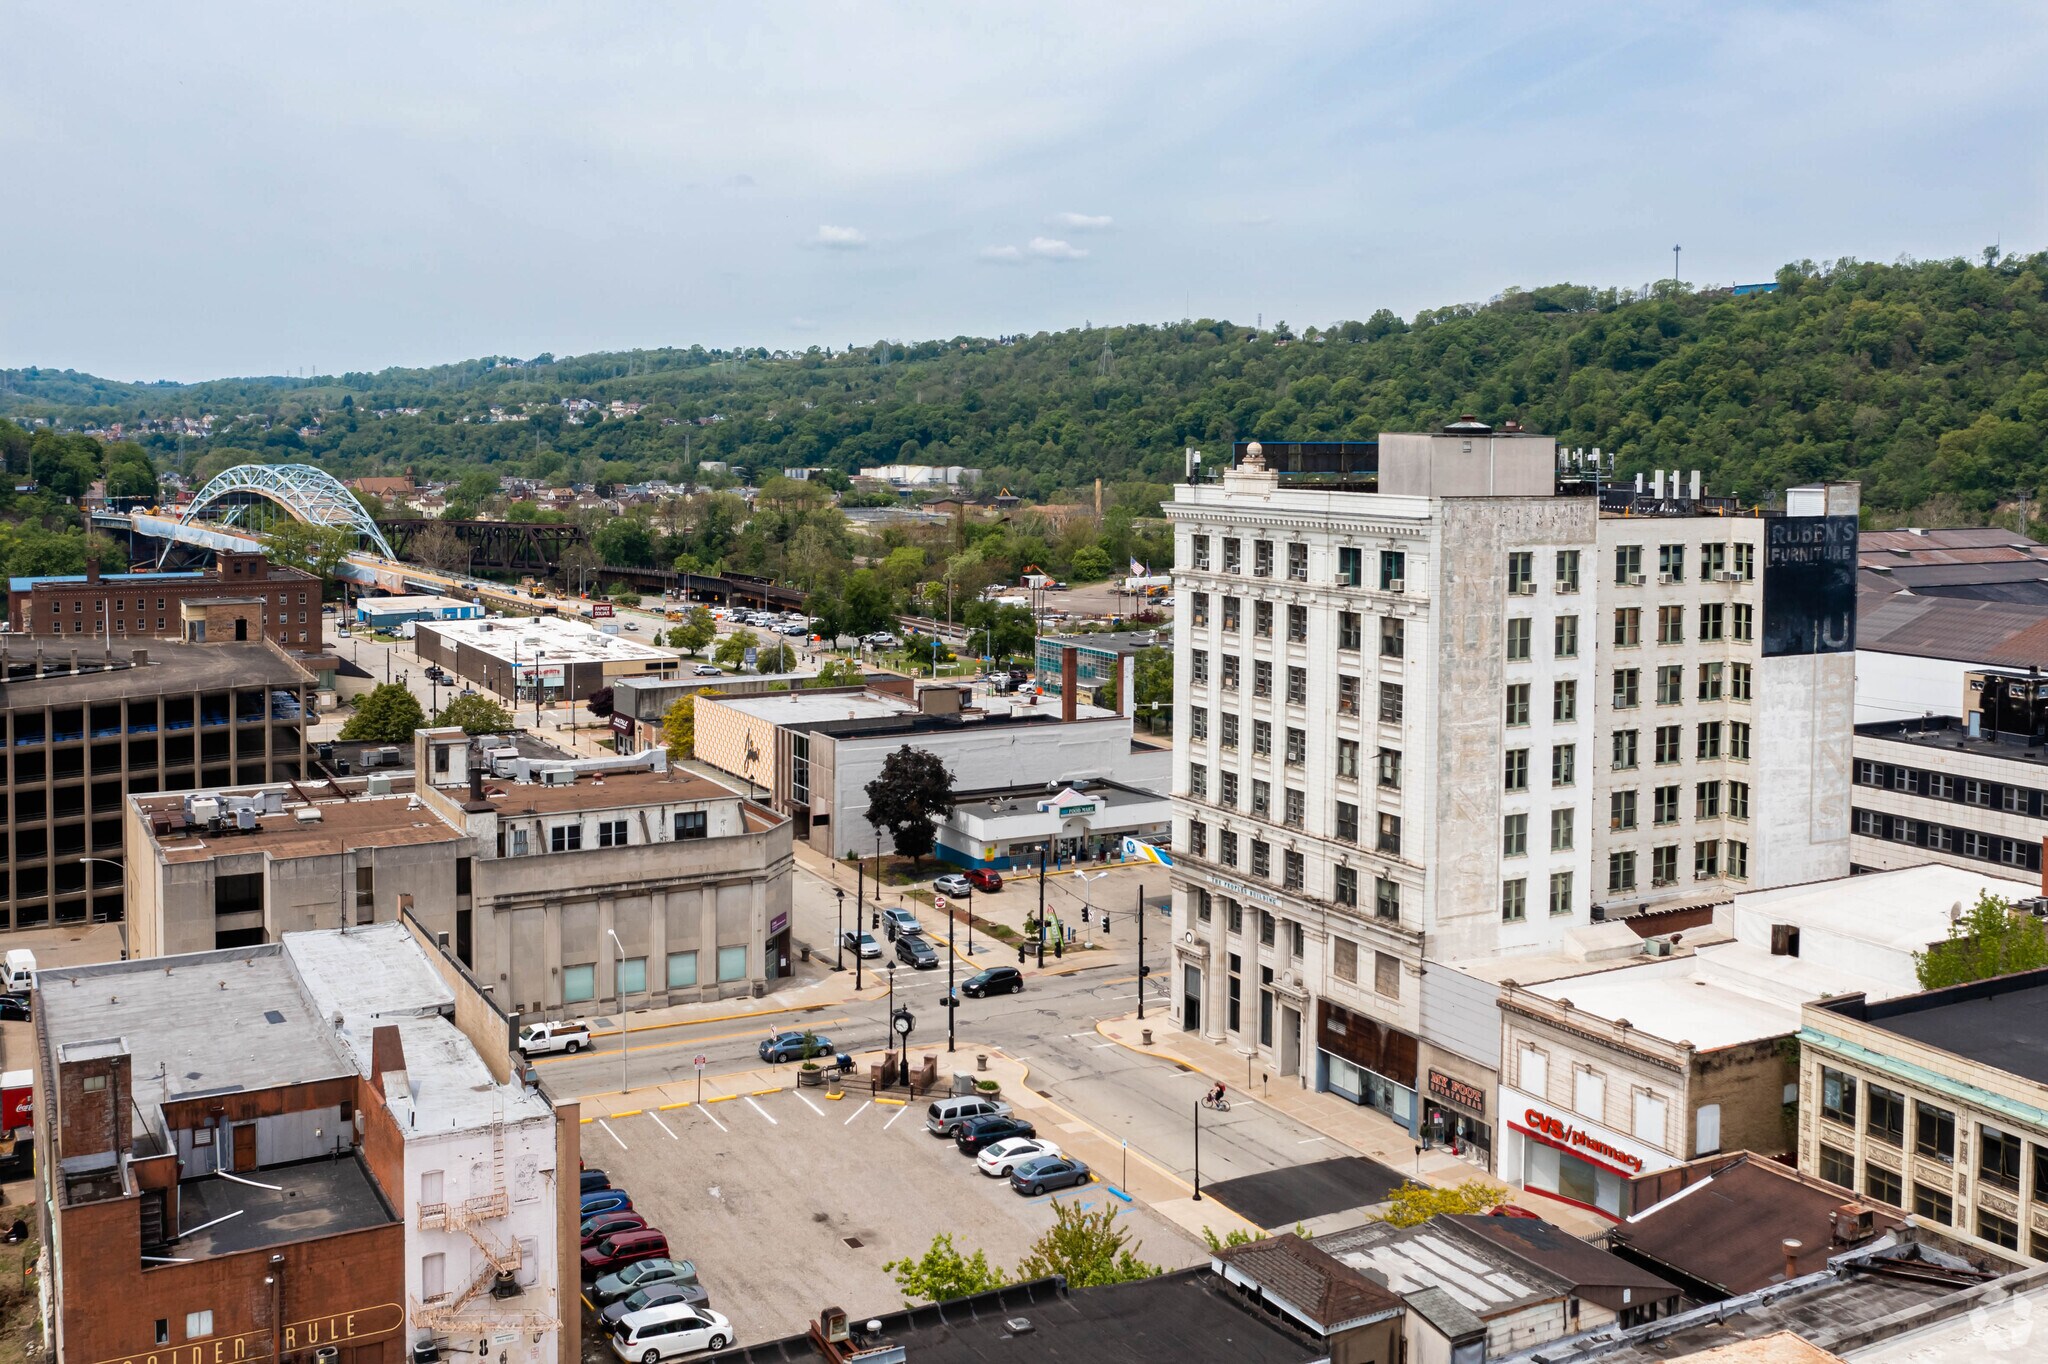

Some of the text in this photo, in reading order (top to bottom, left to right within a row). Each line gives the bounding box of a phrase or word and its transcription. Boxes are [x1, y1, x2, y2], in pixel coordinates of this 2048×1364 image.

[1771, 522, 1856, 545] RUBEN'S
[1771, 546, 1851, 562] FURNITURE
[1211, 877, 1277, 905] THE PEOPLES BUILDING
[1430, 1071, 1482, 1103] MY FOOT
[1430, 1082, 1482, 1111] SPORTSWEAR
[285, 1314, 355, 1349] RULE
